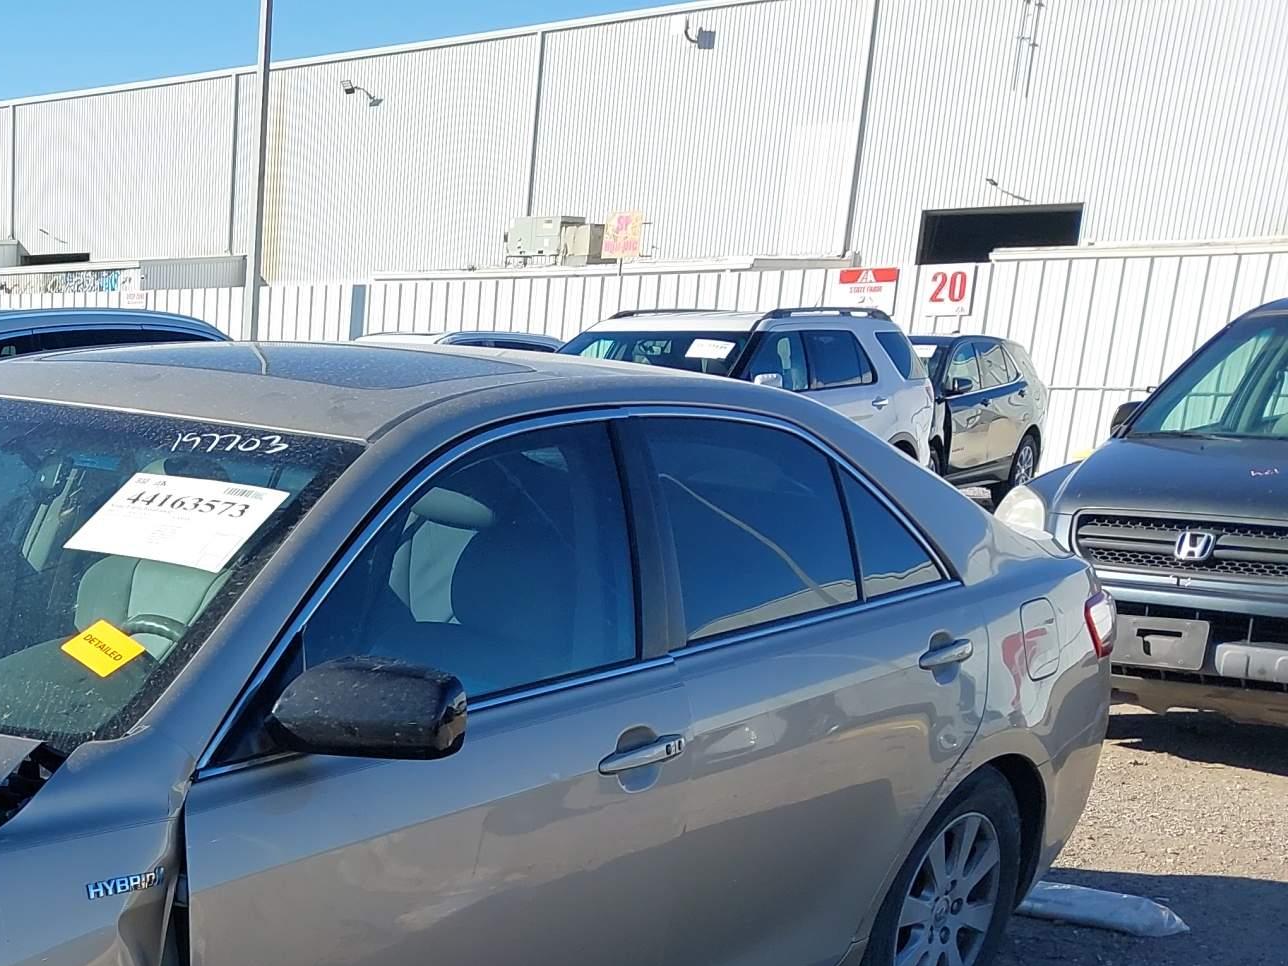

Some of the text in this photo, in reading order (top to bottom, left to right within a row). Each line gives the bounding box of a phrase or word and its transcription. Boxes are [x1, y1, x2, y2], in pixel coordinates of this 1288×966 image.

[929, 271, 967, 303] 20
[170, 432, 289, 454] 197703
[126, 490, 251, 519] 44163573
[83, 633, 123, 661] DETAILED
